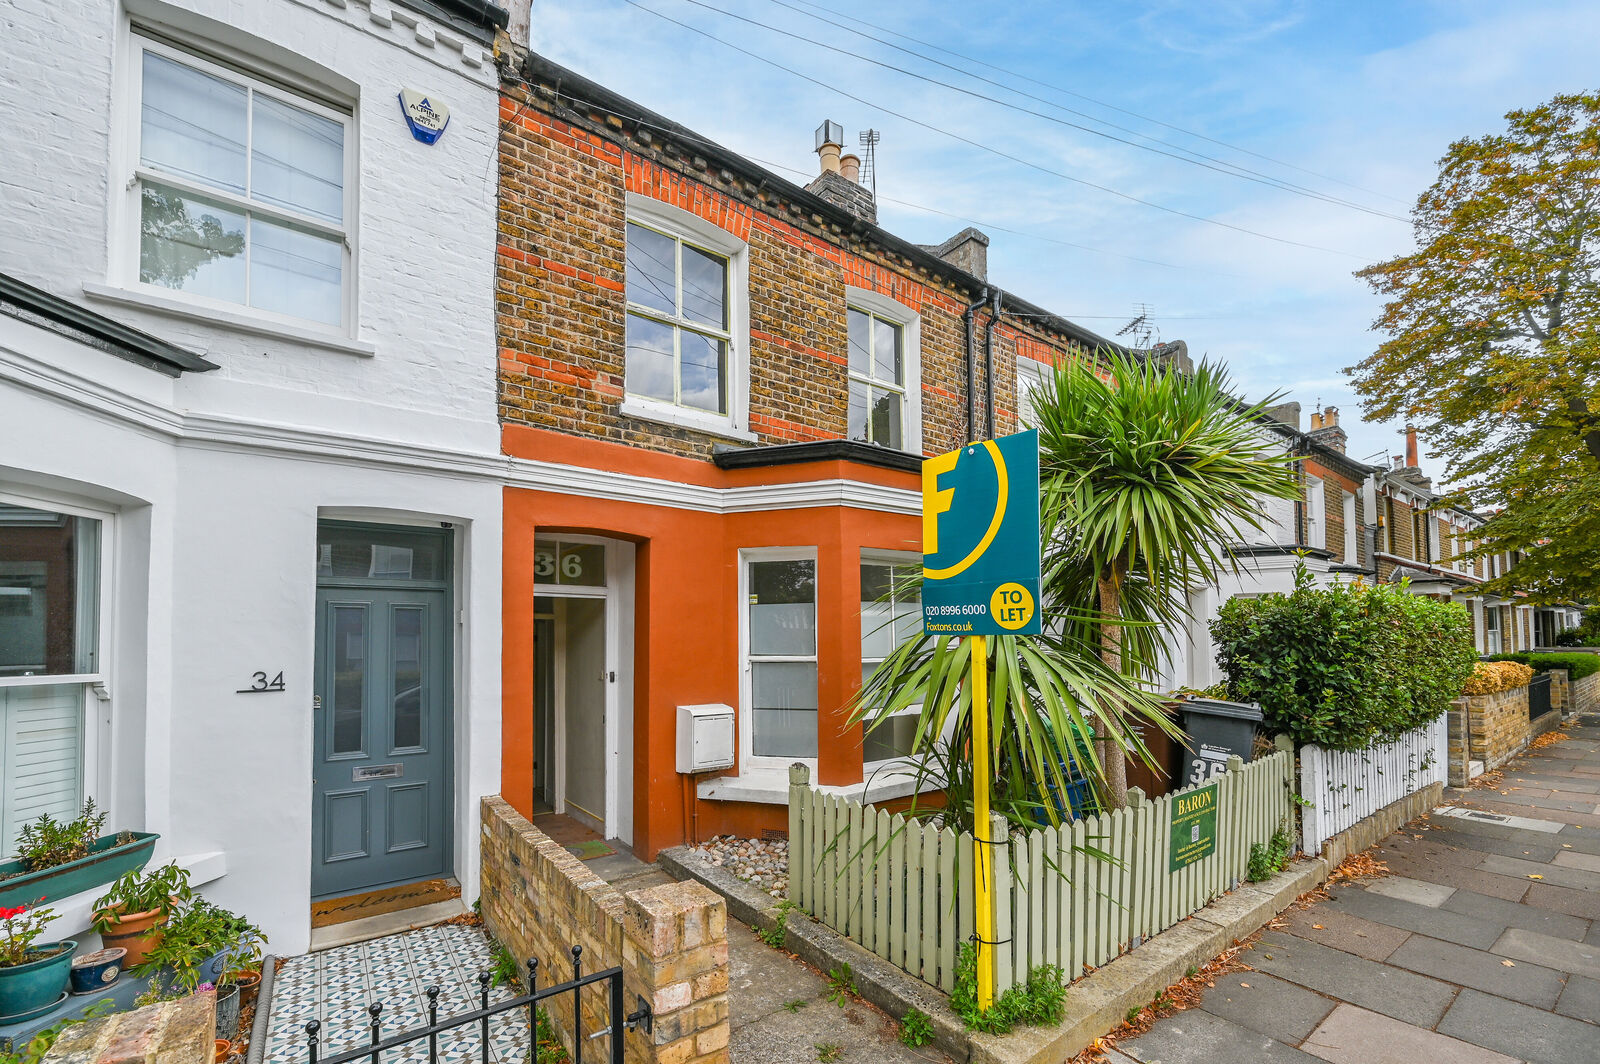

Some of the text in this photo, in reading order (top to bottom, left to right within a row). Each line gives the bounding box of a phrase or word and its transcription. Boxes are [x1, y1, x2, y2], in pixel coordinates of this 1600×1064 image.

[410, 103, 441, 120] ALPINE
[534, 552, 582, 578] 36
[1000, 590, 1022, 604] TO
[926, 604, 986, 616] 020 8996 6000
[1000, 608, 1026, 622] LET
[926, 621, 973, 632] Foxtons.co.uk
[252, 671, 285, 691] 34
[1178, 790, 1212, 816] BARON
